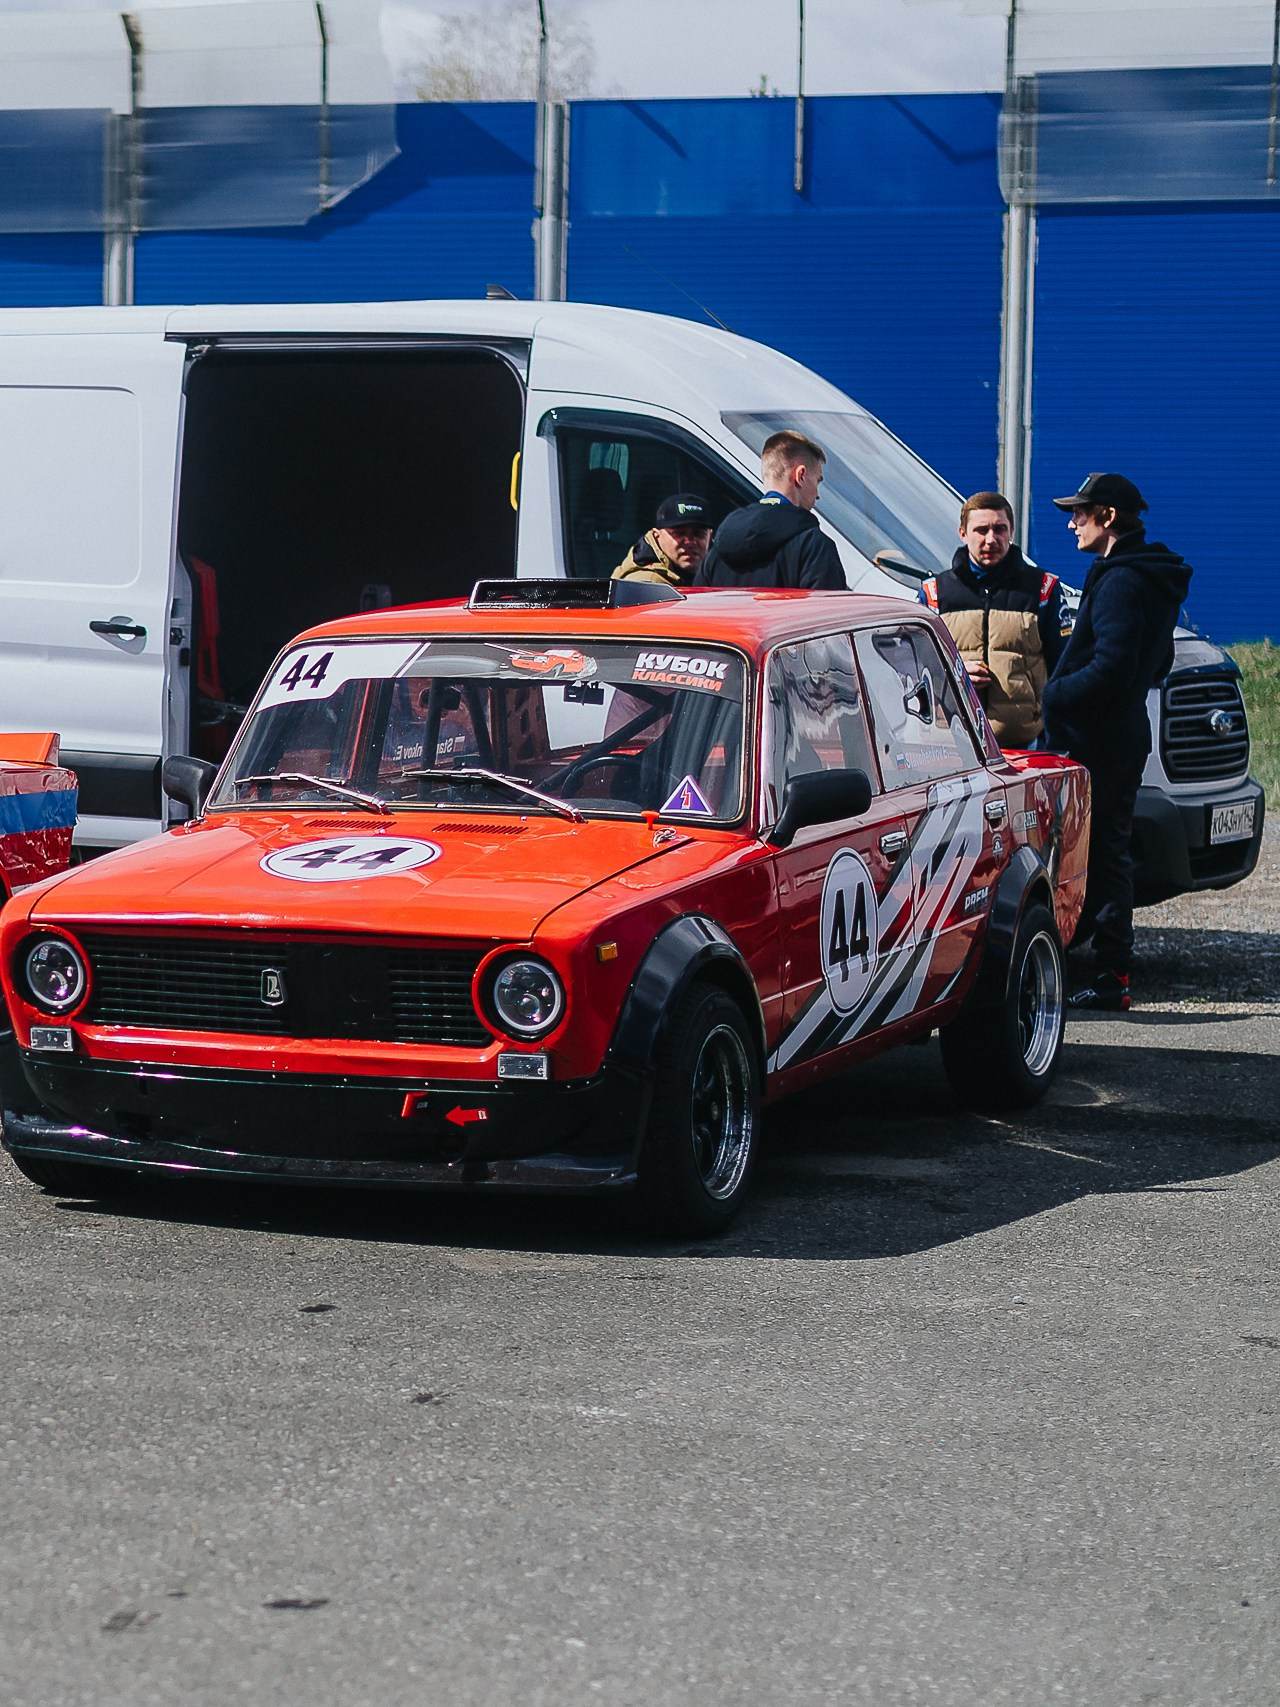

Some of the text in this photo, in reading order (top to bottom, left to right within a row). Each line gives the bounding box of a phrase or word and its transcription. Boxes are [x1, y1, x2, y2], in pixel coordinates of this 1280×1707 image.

[279, 652, 334, 692] 44
[634, 653, 728, 679] КУБОК
[632, 670, 723, 692] КЛАССИКИ
[281, 845, 413, 870] 44
[828, 881, 870, 983] 44
